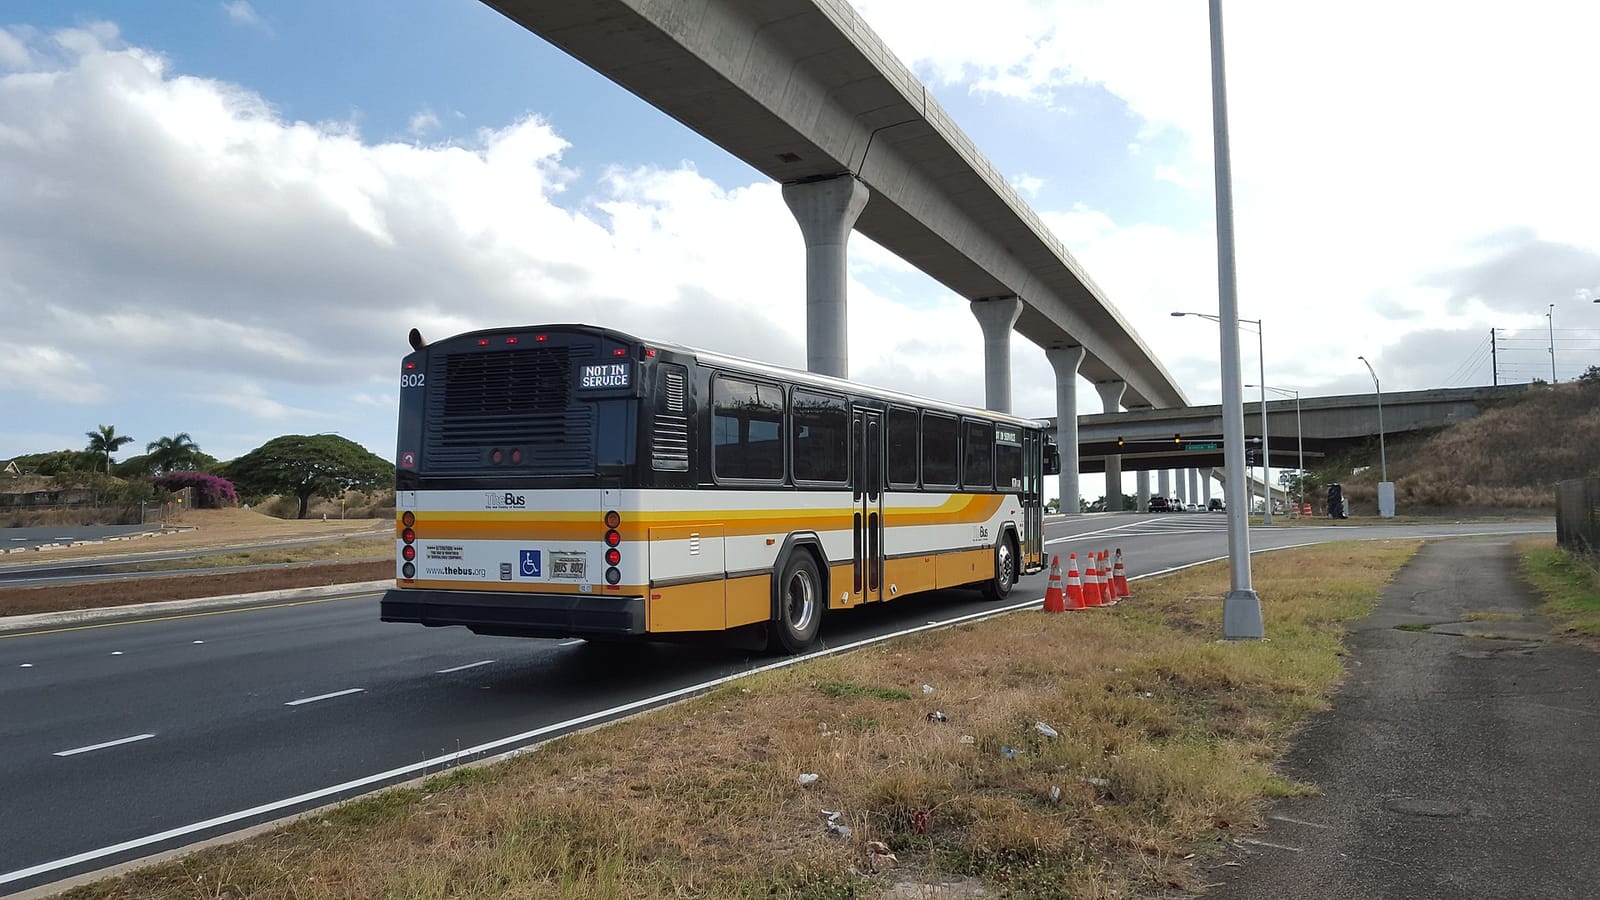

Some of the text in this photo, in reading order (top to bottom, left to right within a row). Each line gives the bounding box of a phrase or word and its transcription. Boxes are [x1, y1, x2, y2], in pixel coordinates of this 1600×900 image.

[586, 364, 624, 376] NOT IN
[401, 373, 425, 387] 802
[583, 375, 628, 386] SERVICE
[485, 492, 525, 506] TheBus
[425, 566, 486, 577] www.thebus.org
[570, 562, 584, 574] 802
